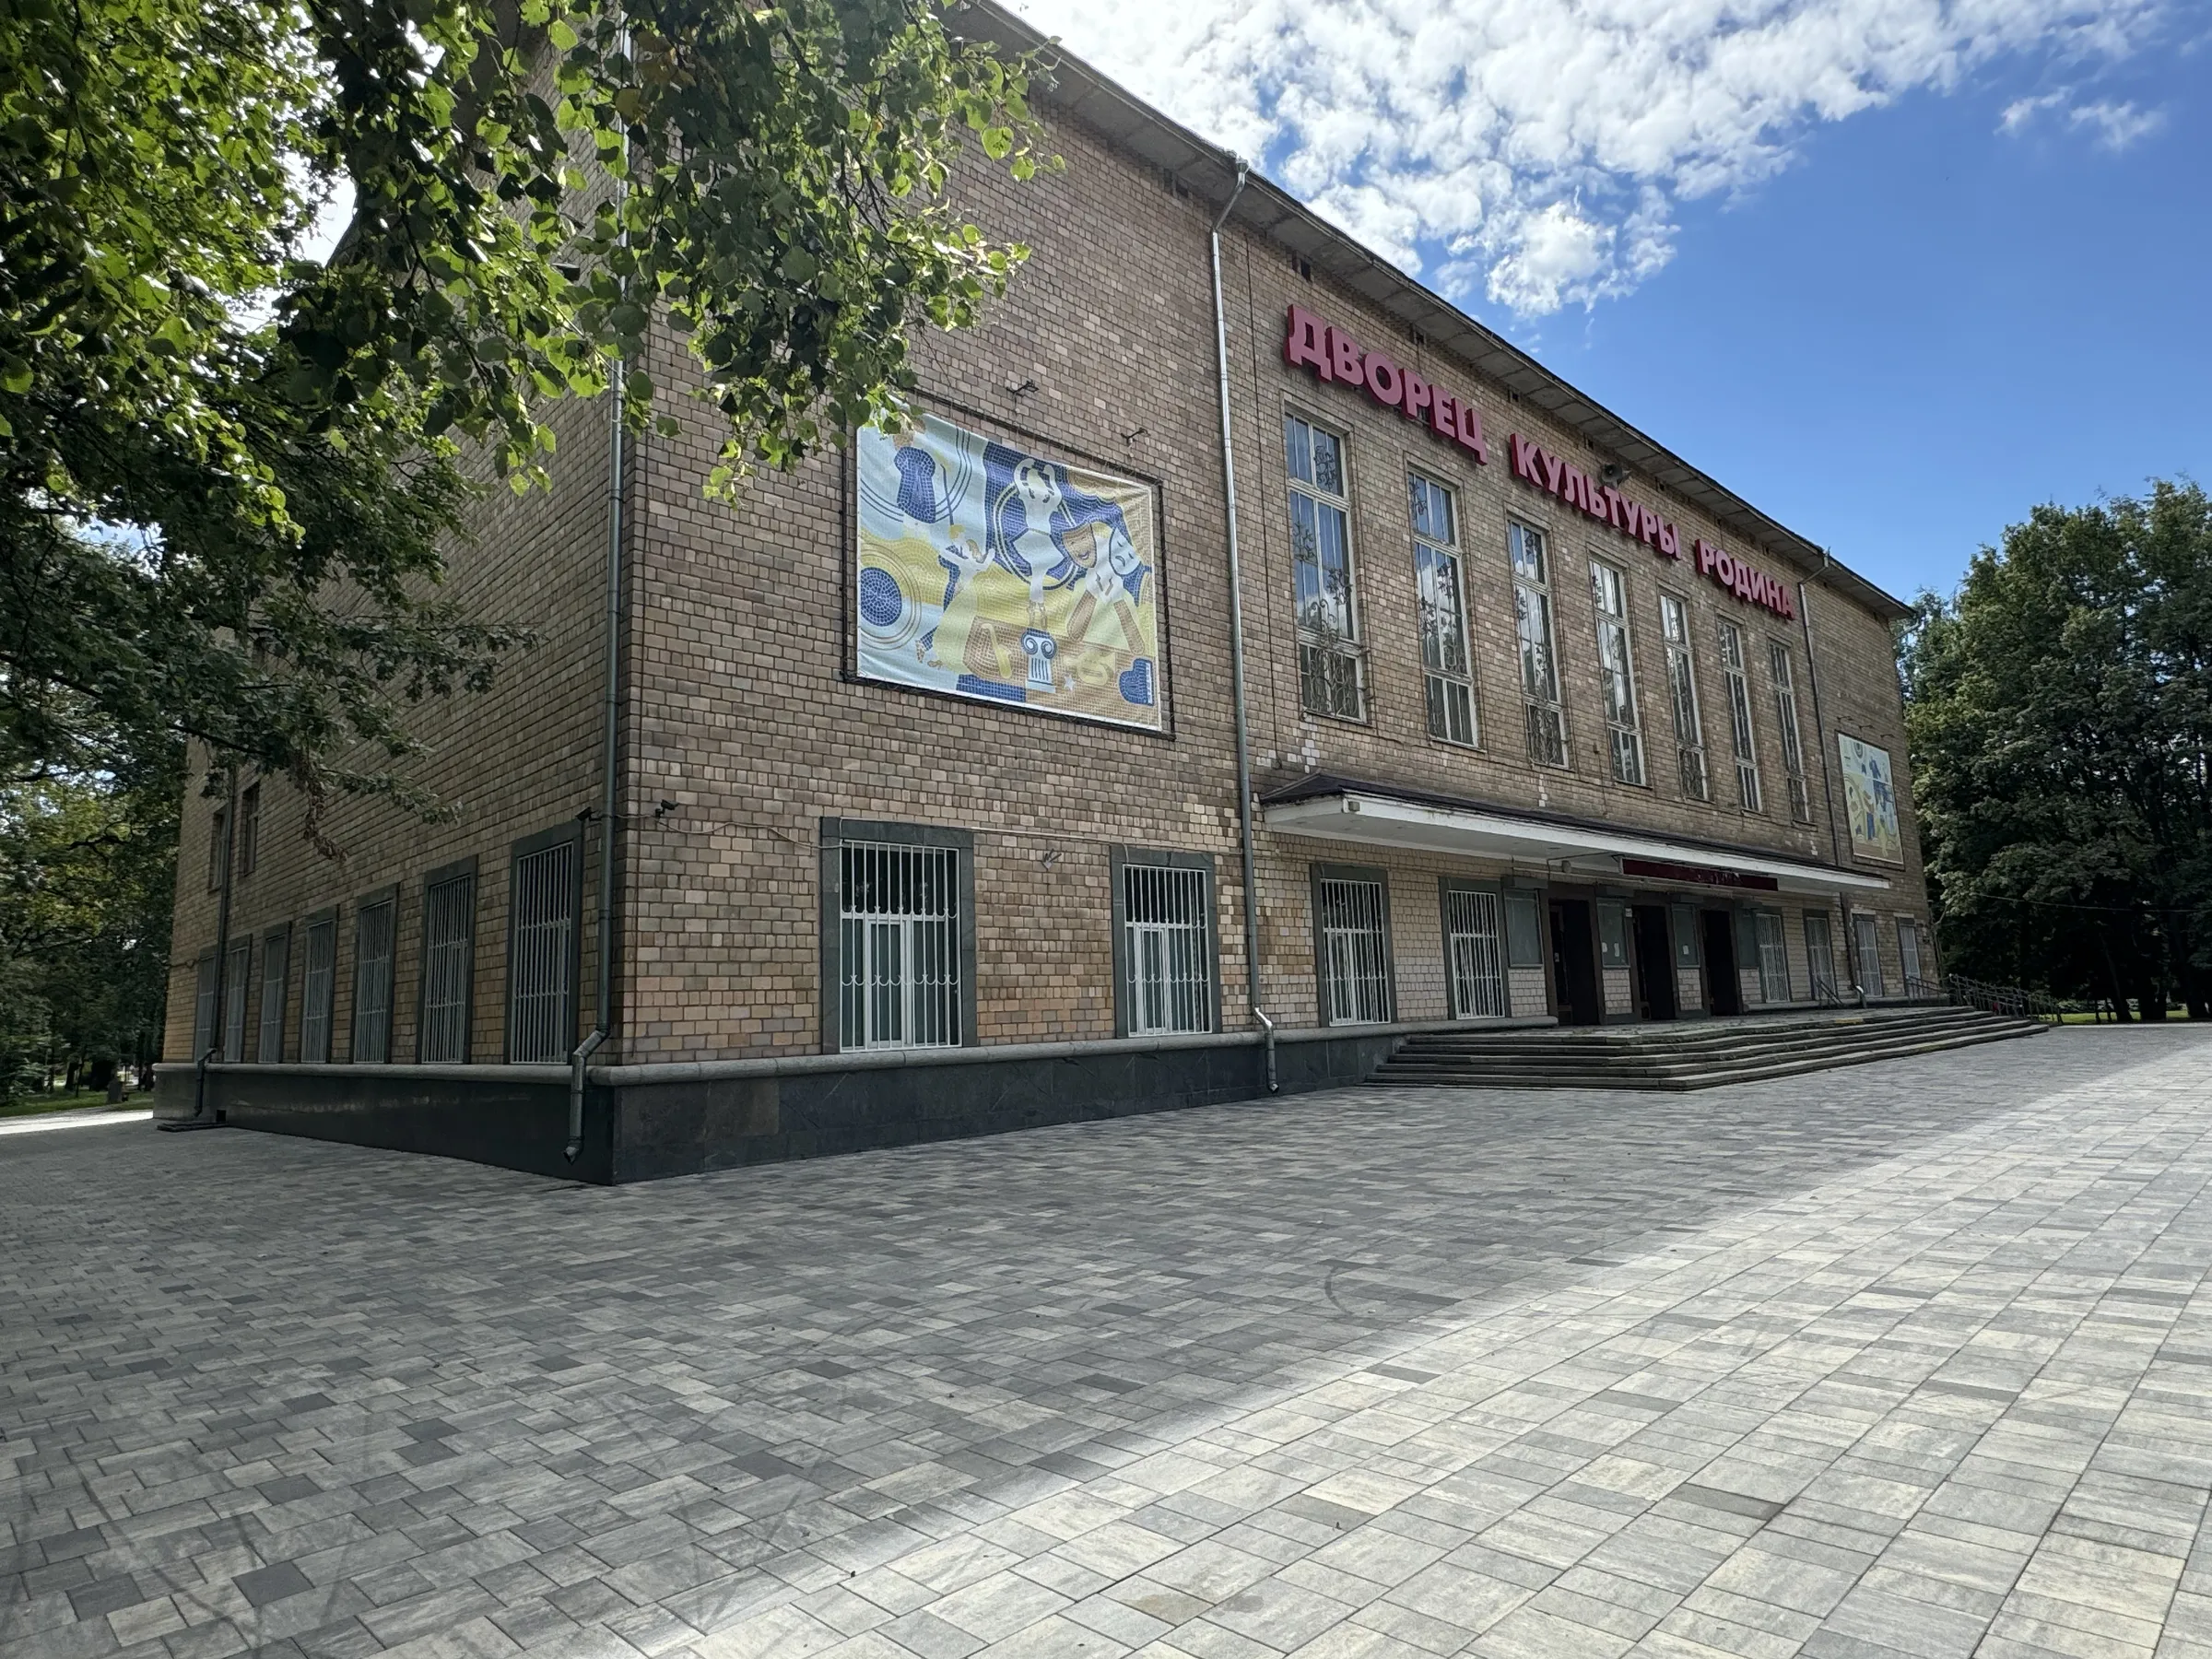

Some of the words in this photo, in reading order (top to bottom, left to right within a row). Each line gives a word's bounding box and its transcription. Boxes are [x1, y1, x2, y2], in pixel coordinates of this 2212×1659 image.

[1285, 304, 1488, 465] ДВОРЕЦ
[1511, 433, 1682, 561] КУЛЬТУРЫ
[1695, 538, 1795, 620] РОДИНА
